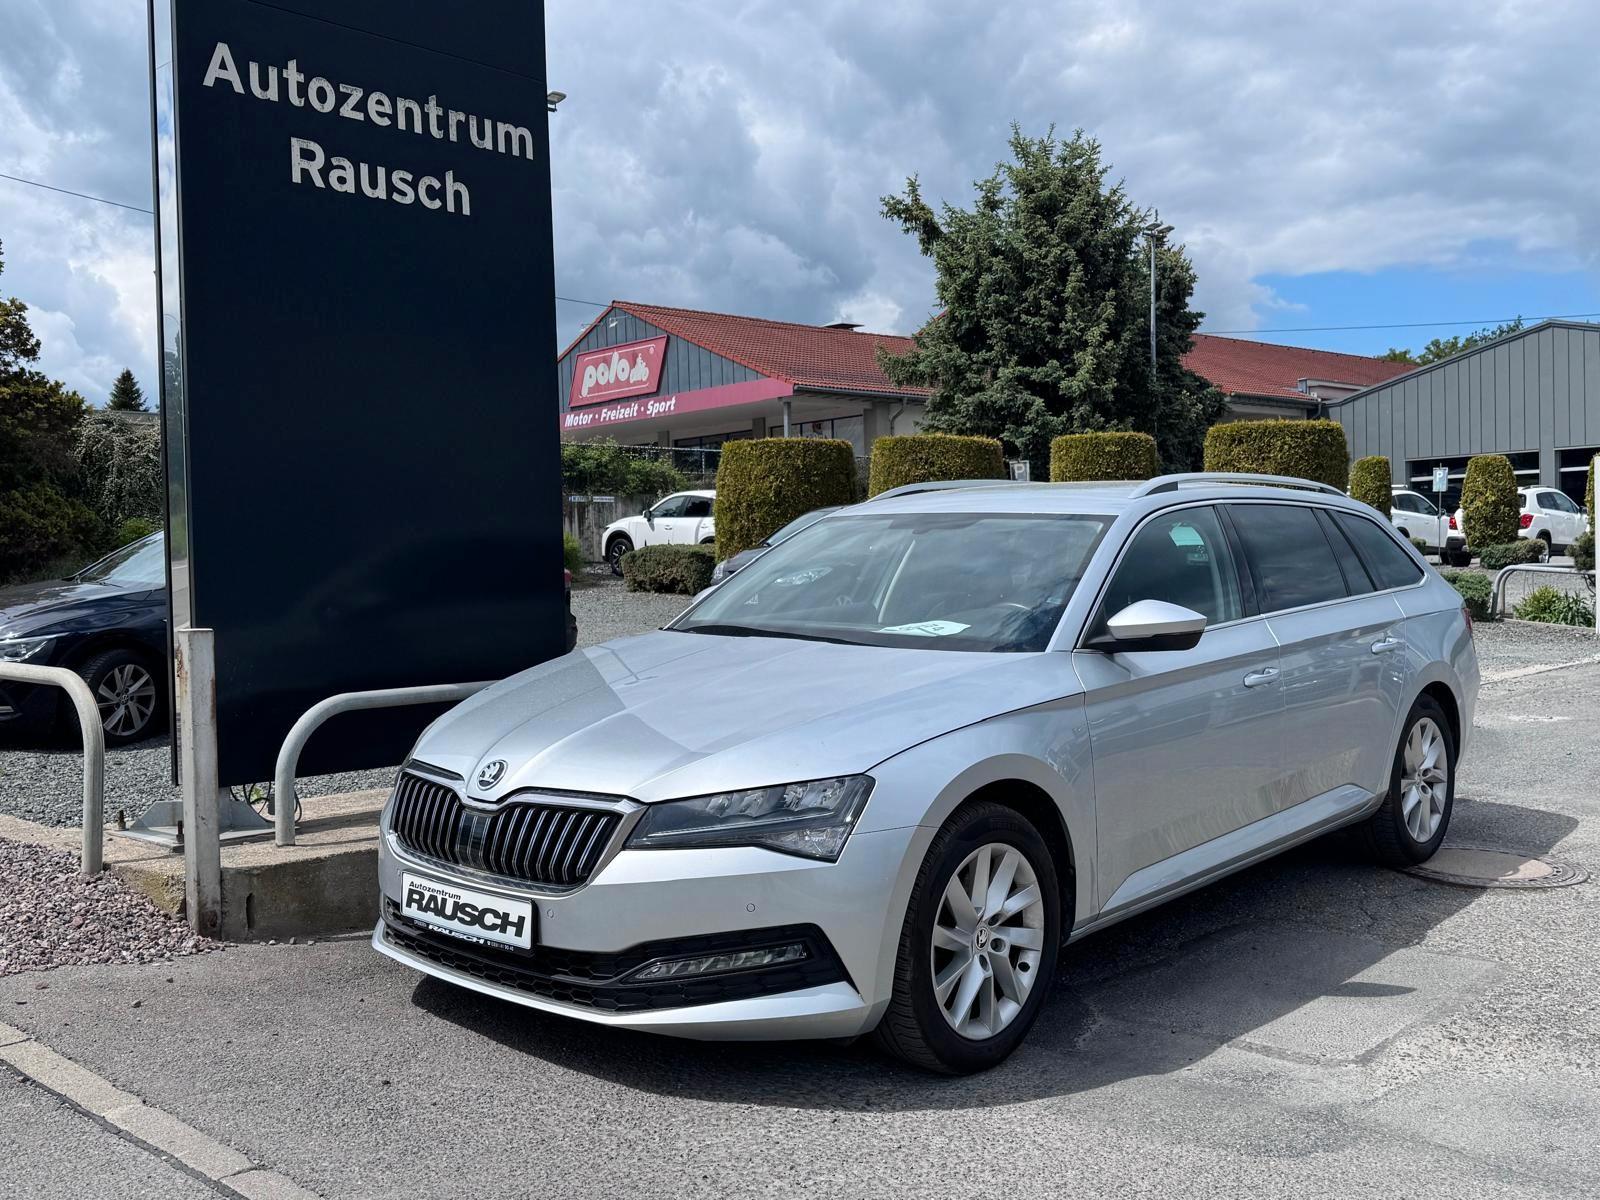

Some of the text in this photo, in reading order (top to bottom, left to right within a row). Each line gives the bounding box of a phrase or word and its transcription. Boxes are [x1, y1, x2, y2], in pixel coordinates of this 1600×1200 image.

[203, 42, 534, 160] Autozentrum
[290, 137, 471, 216] Rausch
[581, 351, 630, 397] polo
[564, 396, 676, 427] Motor Freizeit Sport
[1014, 463, 1025, 479] P
[1436, 471, 1444, 482] P
[409, 881, 461, 901] Autozentrum
[405, 888, 526, 938] RAUSCH
